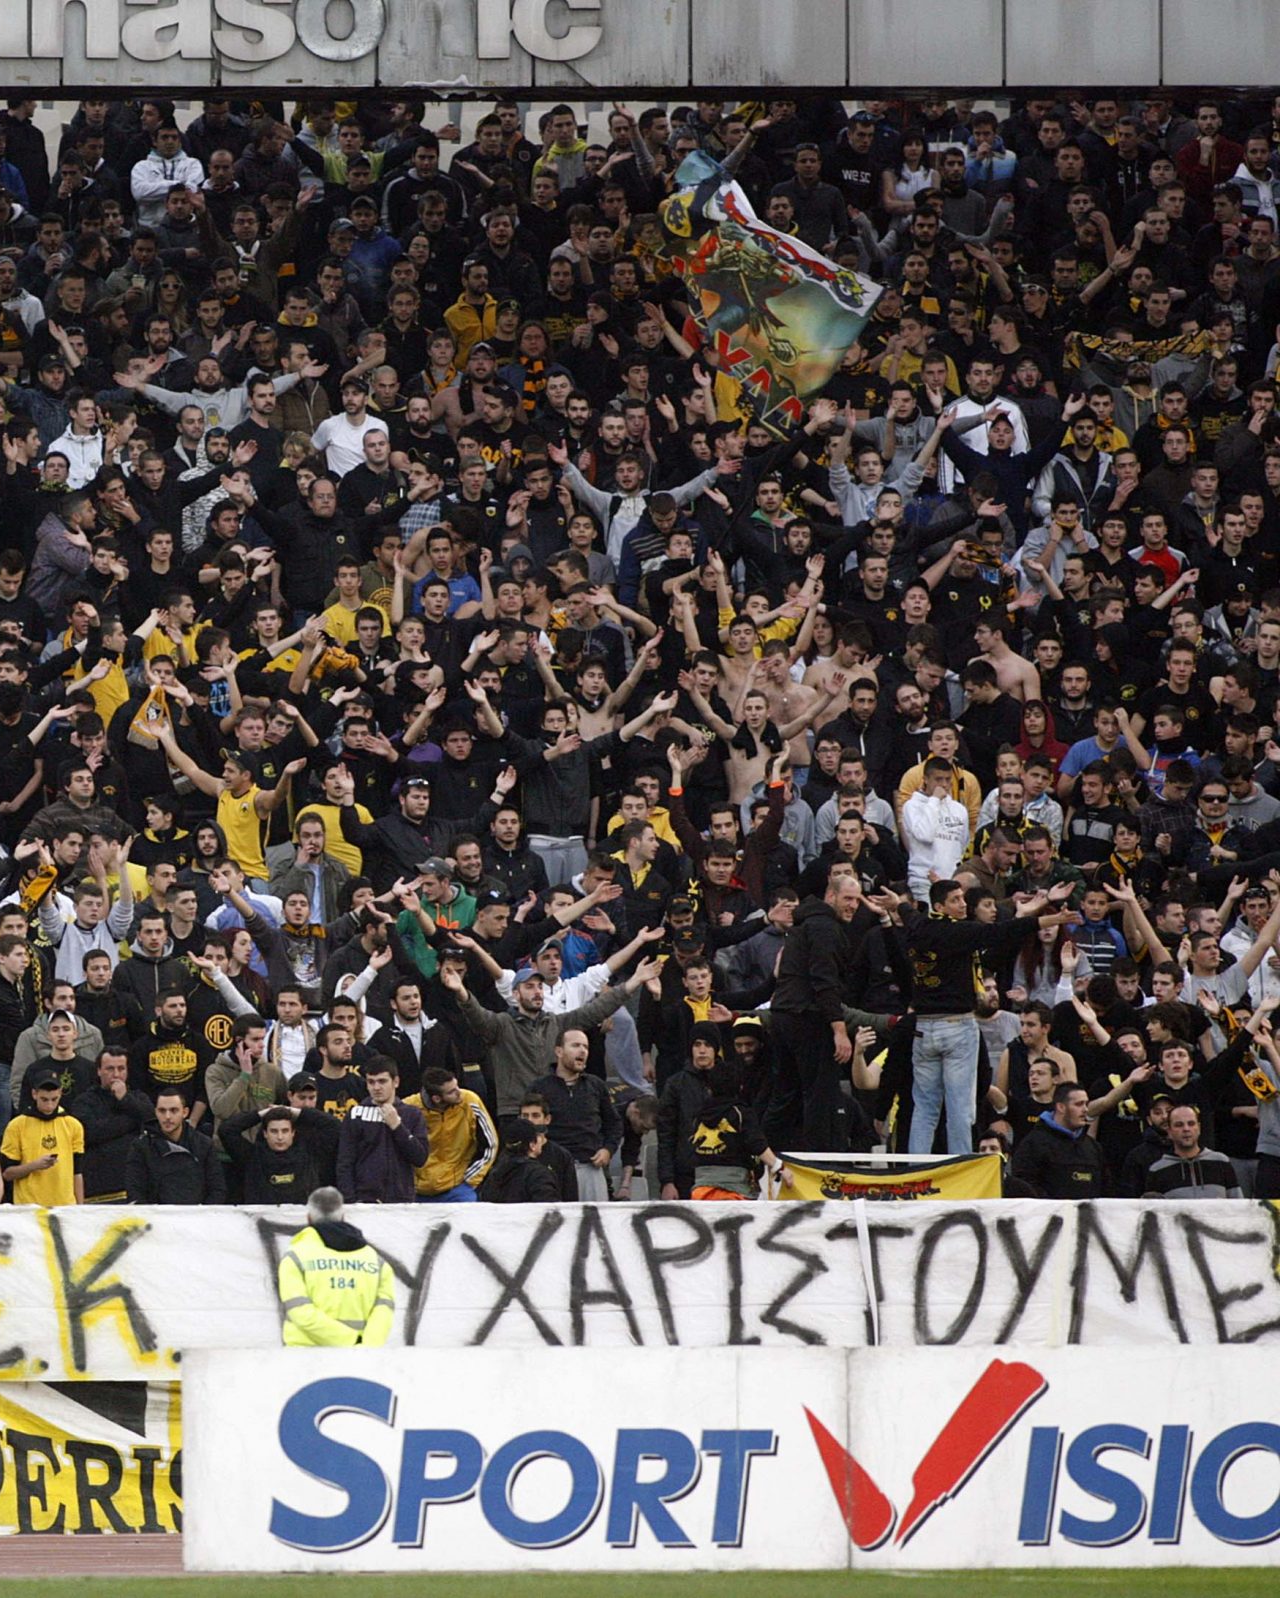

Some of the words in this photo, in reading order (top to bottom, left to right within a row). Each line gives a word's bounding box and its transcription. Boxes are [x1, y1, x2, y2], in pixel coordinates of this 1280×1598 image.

[351, 1105, 384, 1123] PUM
[317, 1259, 379, 1275] BRINKS
[329, 1277, 356, 1289] 184
[269, 1377, 779, 1554] SPORT
